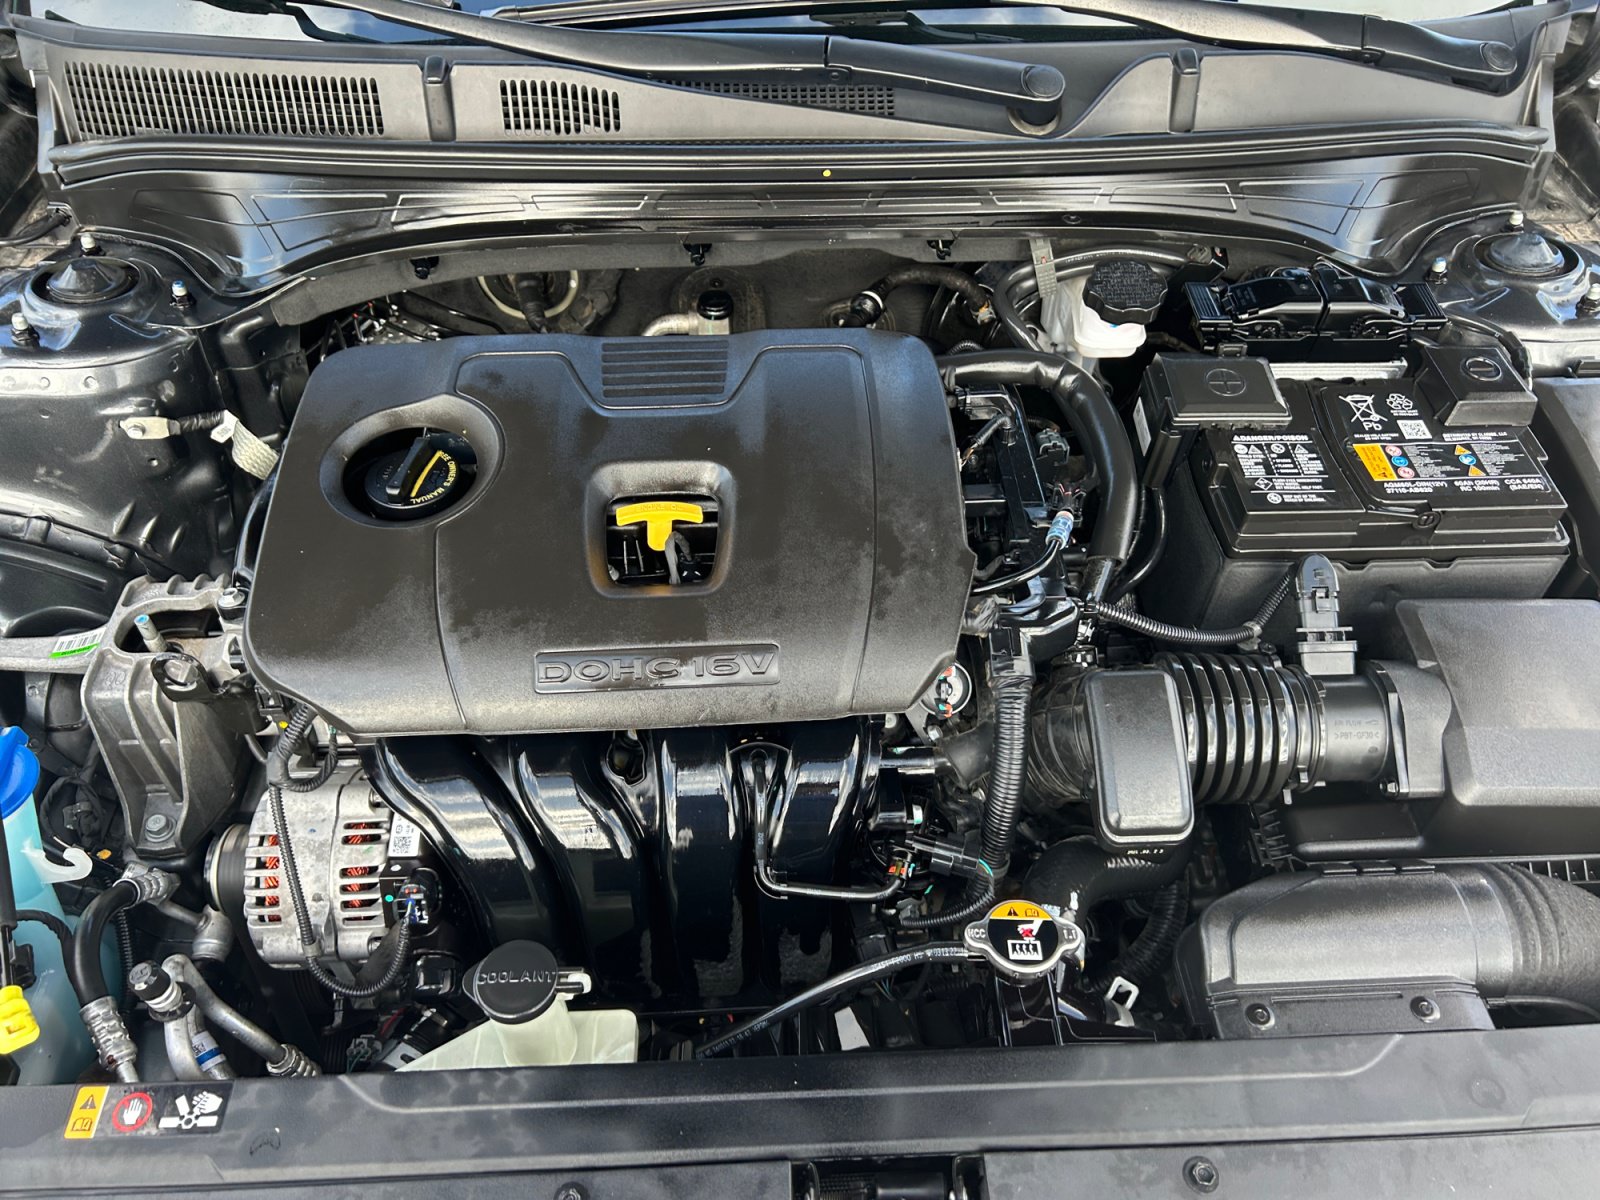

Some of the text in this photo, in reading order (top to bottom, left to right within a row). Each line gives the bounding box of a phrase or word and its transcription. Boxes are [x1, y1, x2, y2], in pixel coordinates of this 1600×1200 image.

[1362, 422, 1383, 431] Pb
[443, 460, 457, 487] OWNER'S
[410, 487, 445, 505] MANUAL
[538, 652, 775, 683] DOHC 16V
[476, 970, 556, 985] COOLANT
